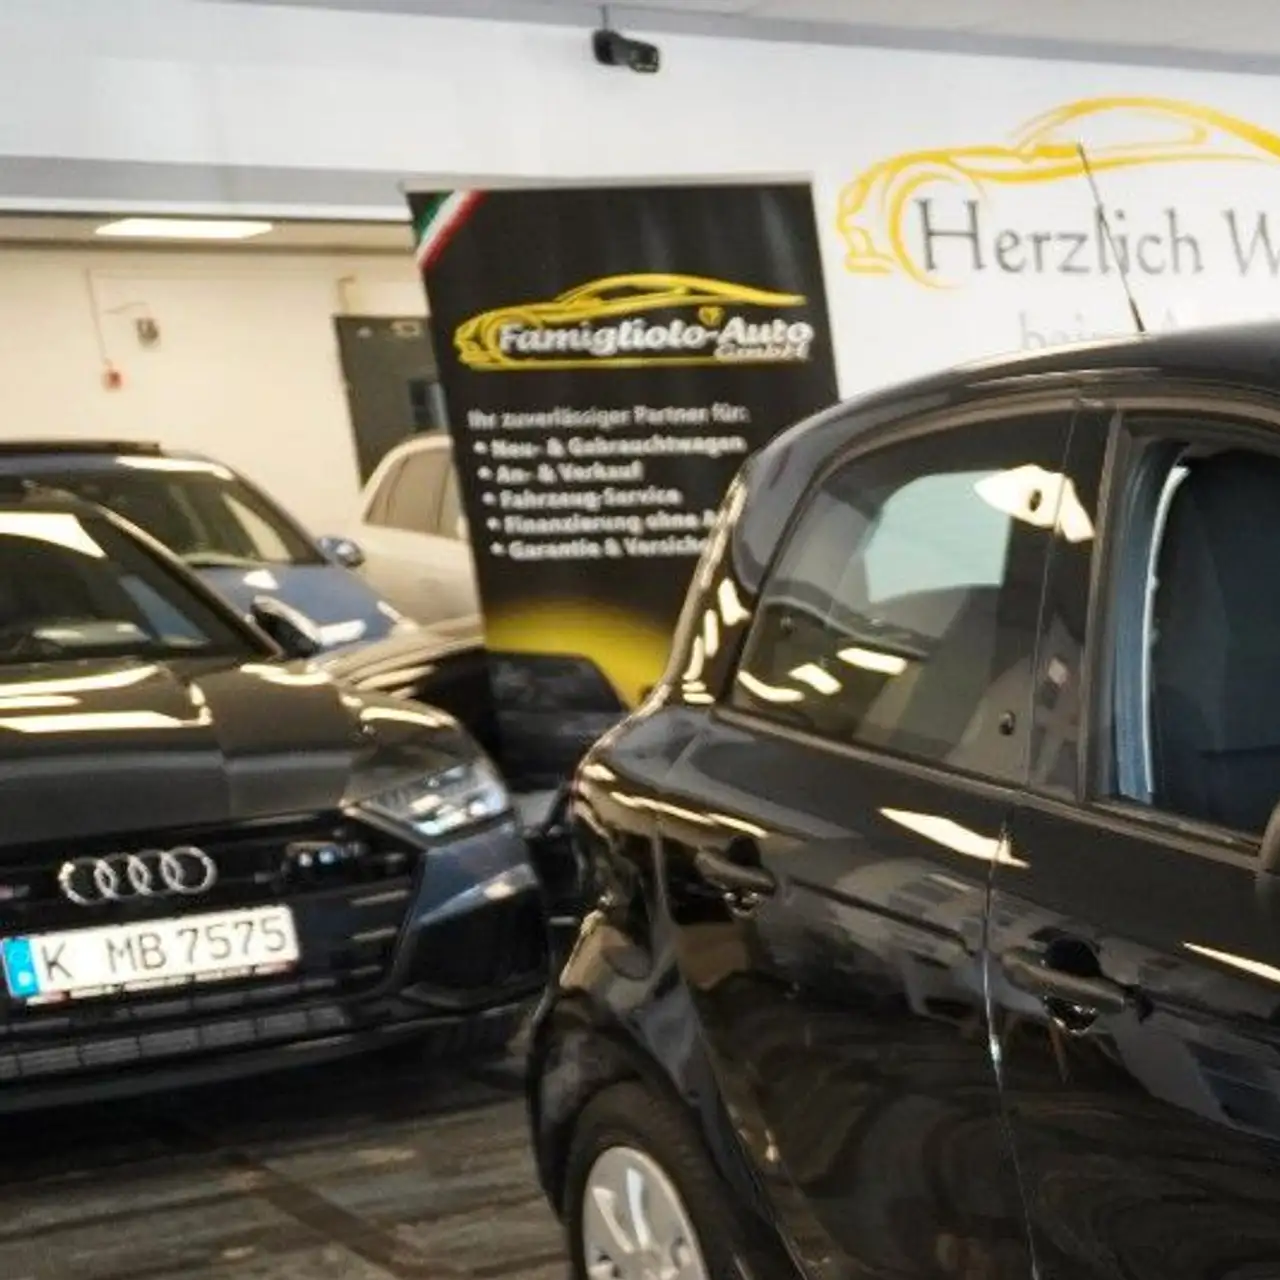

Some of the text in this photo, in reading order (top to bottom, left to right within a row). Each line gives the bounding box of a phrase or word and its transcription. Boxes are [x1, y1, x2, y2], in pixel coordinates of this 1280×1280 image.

[914, 197, 1204, 274] Herzlich
[467, 409, 497, 429] Ihr
[633, 405, 708, 425] Partner
[41, 942, 73, 982] K
[104, 932, 167, 973] MB
[175, 915, 287, 966] 7575
